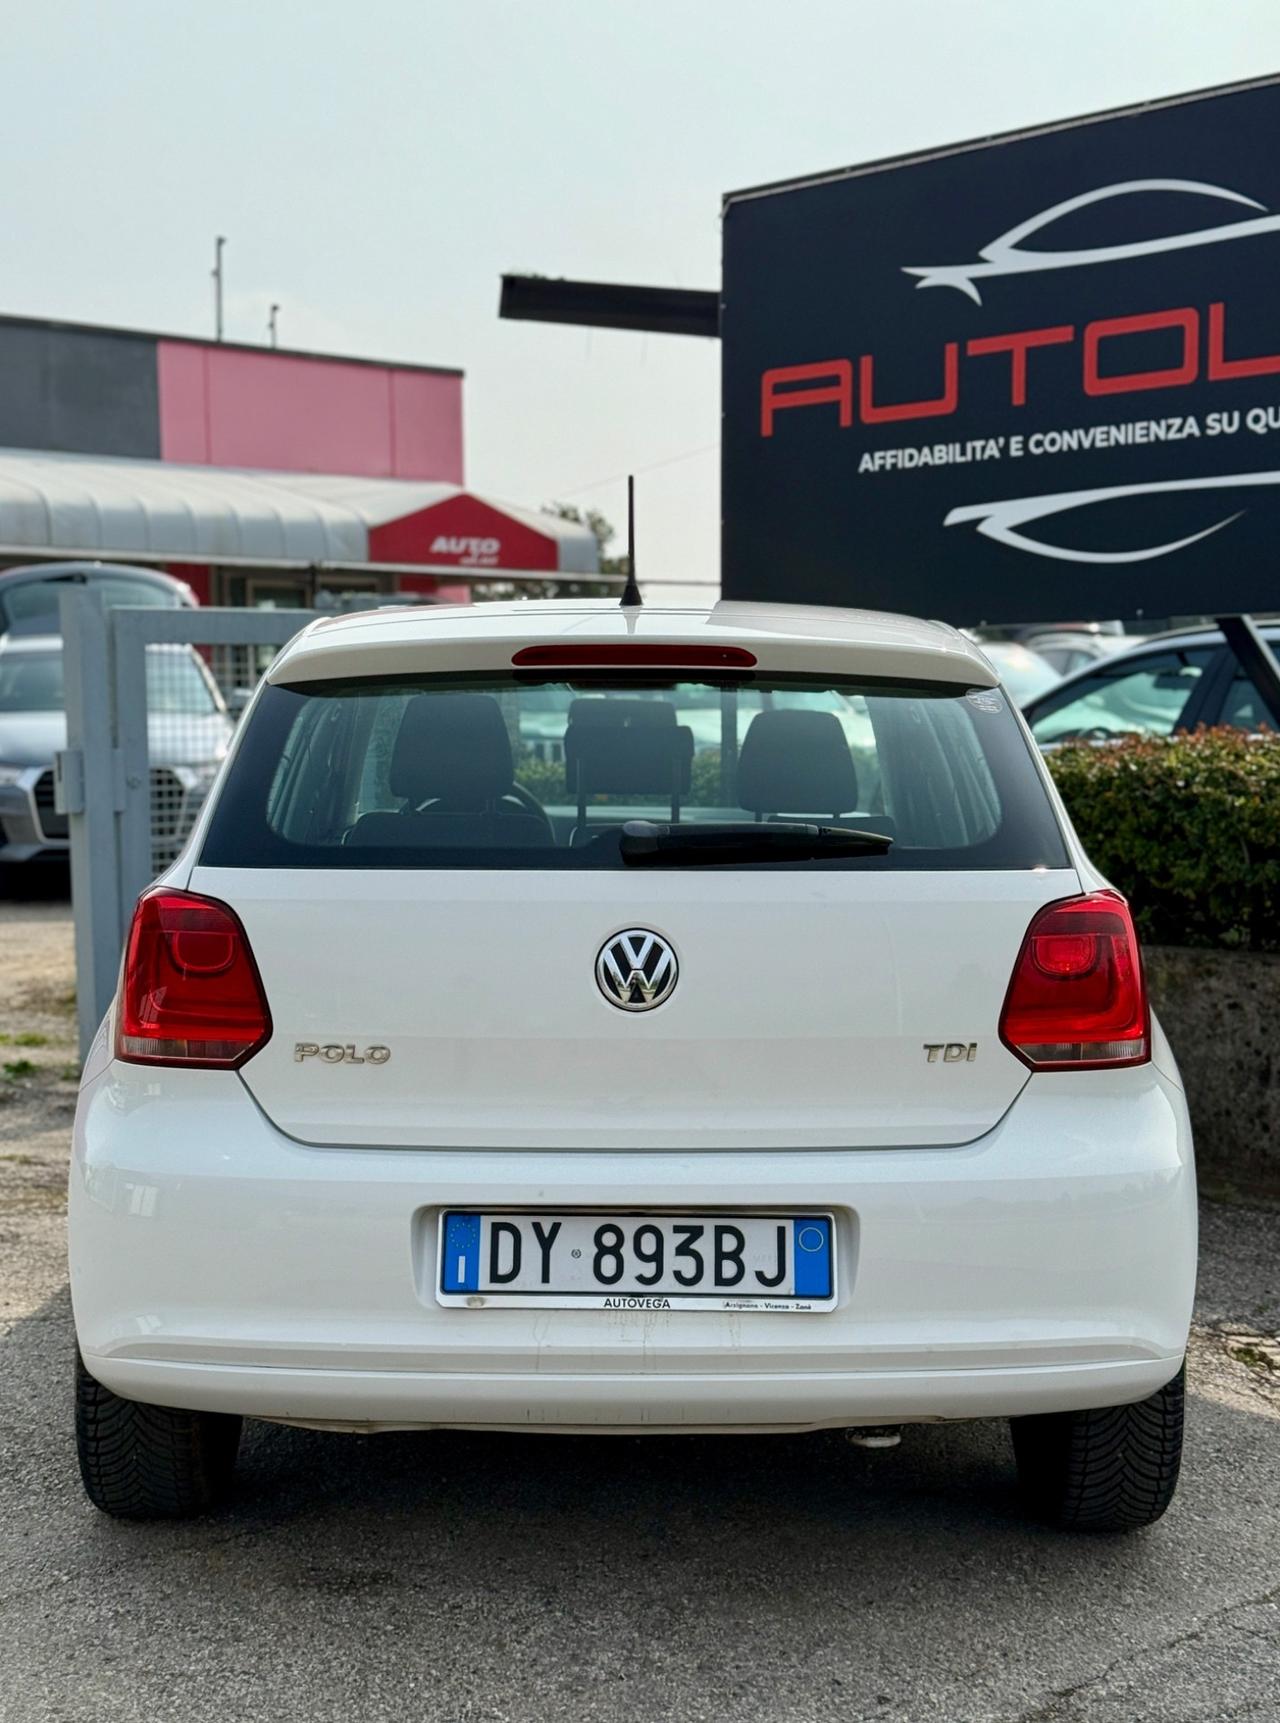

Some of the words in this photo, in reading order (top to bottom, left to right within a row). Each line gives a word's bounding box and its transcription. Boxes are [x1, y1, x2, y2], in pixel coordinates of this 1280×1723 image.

[1010, 437, 1023, 457] E
[1028, 415, 1201, 455] CONVENIENZA
[1206, 411, 1239, 436] SU
[430, 536, 501, 553] AUTO
[294, 1043, 391, 1065] POLO
[923, 1042, 977, 1063] TDI
[489, 1221, 562, 1284] DY
[593, 1223, 787, 1288] 893BJ
[604, 1298, 671, 1309] AUTOVEGA
